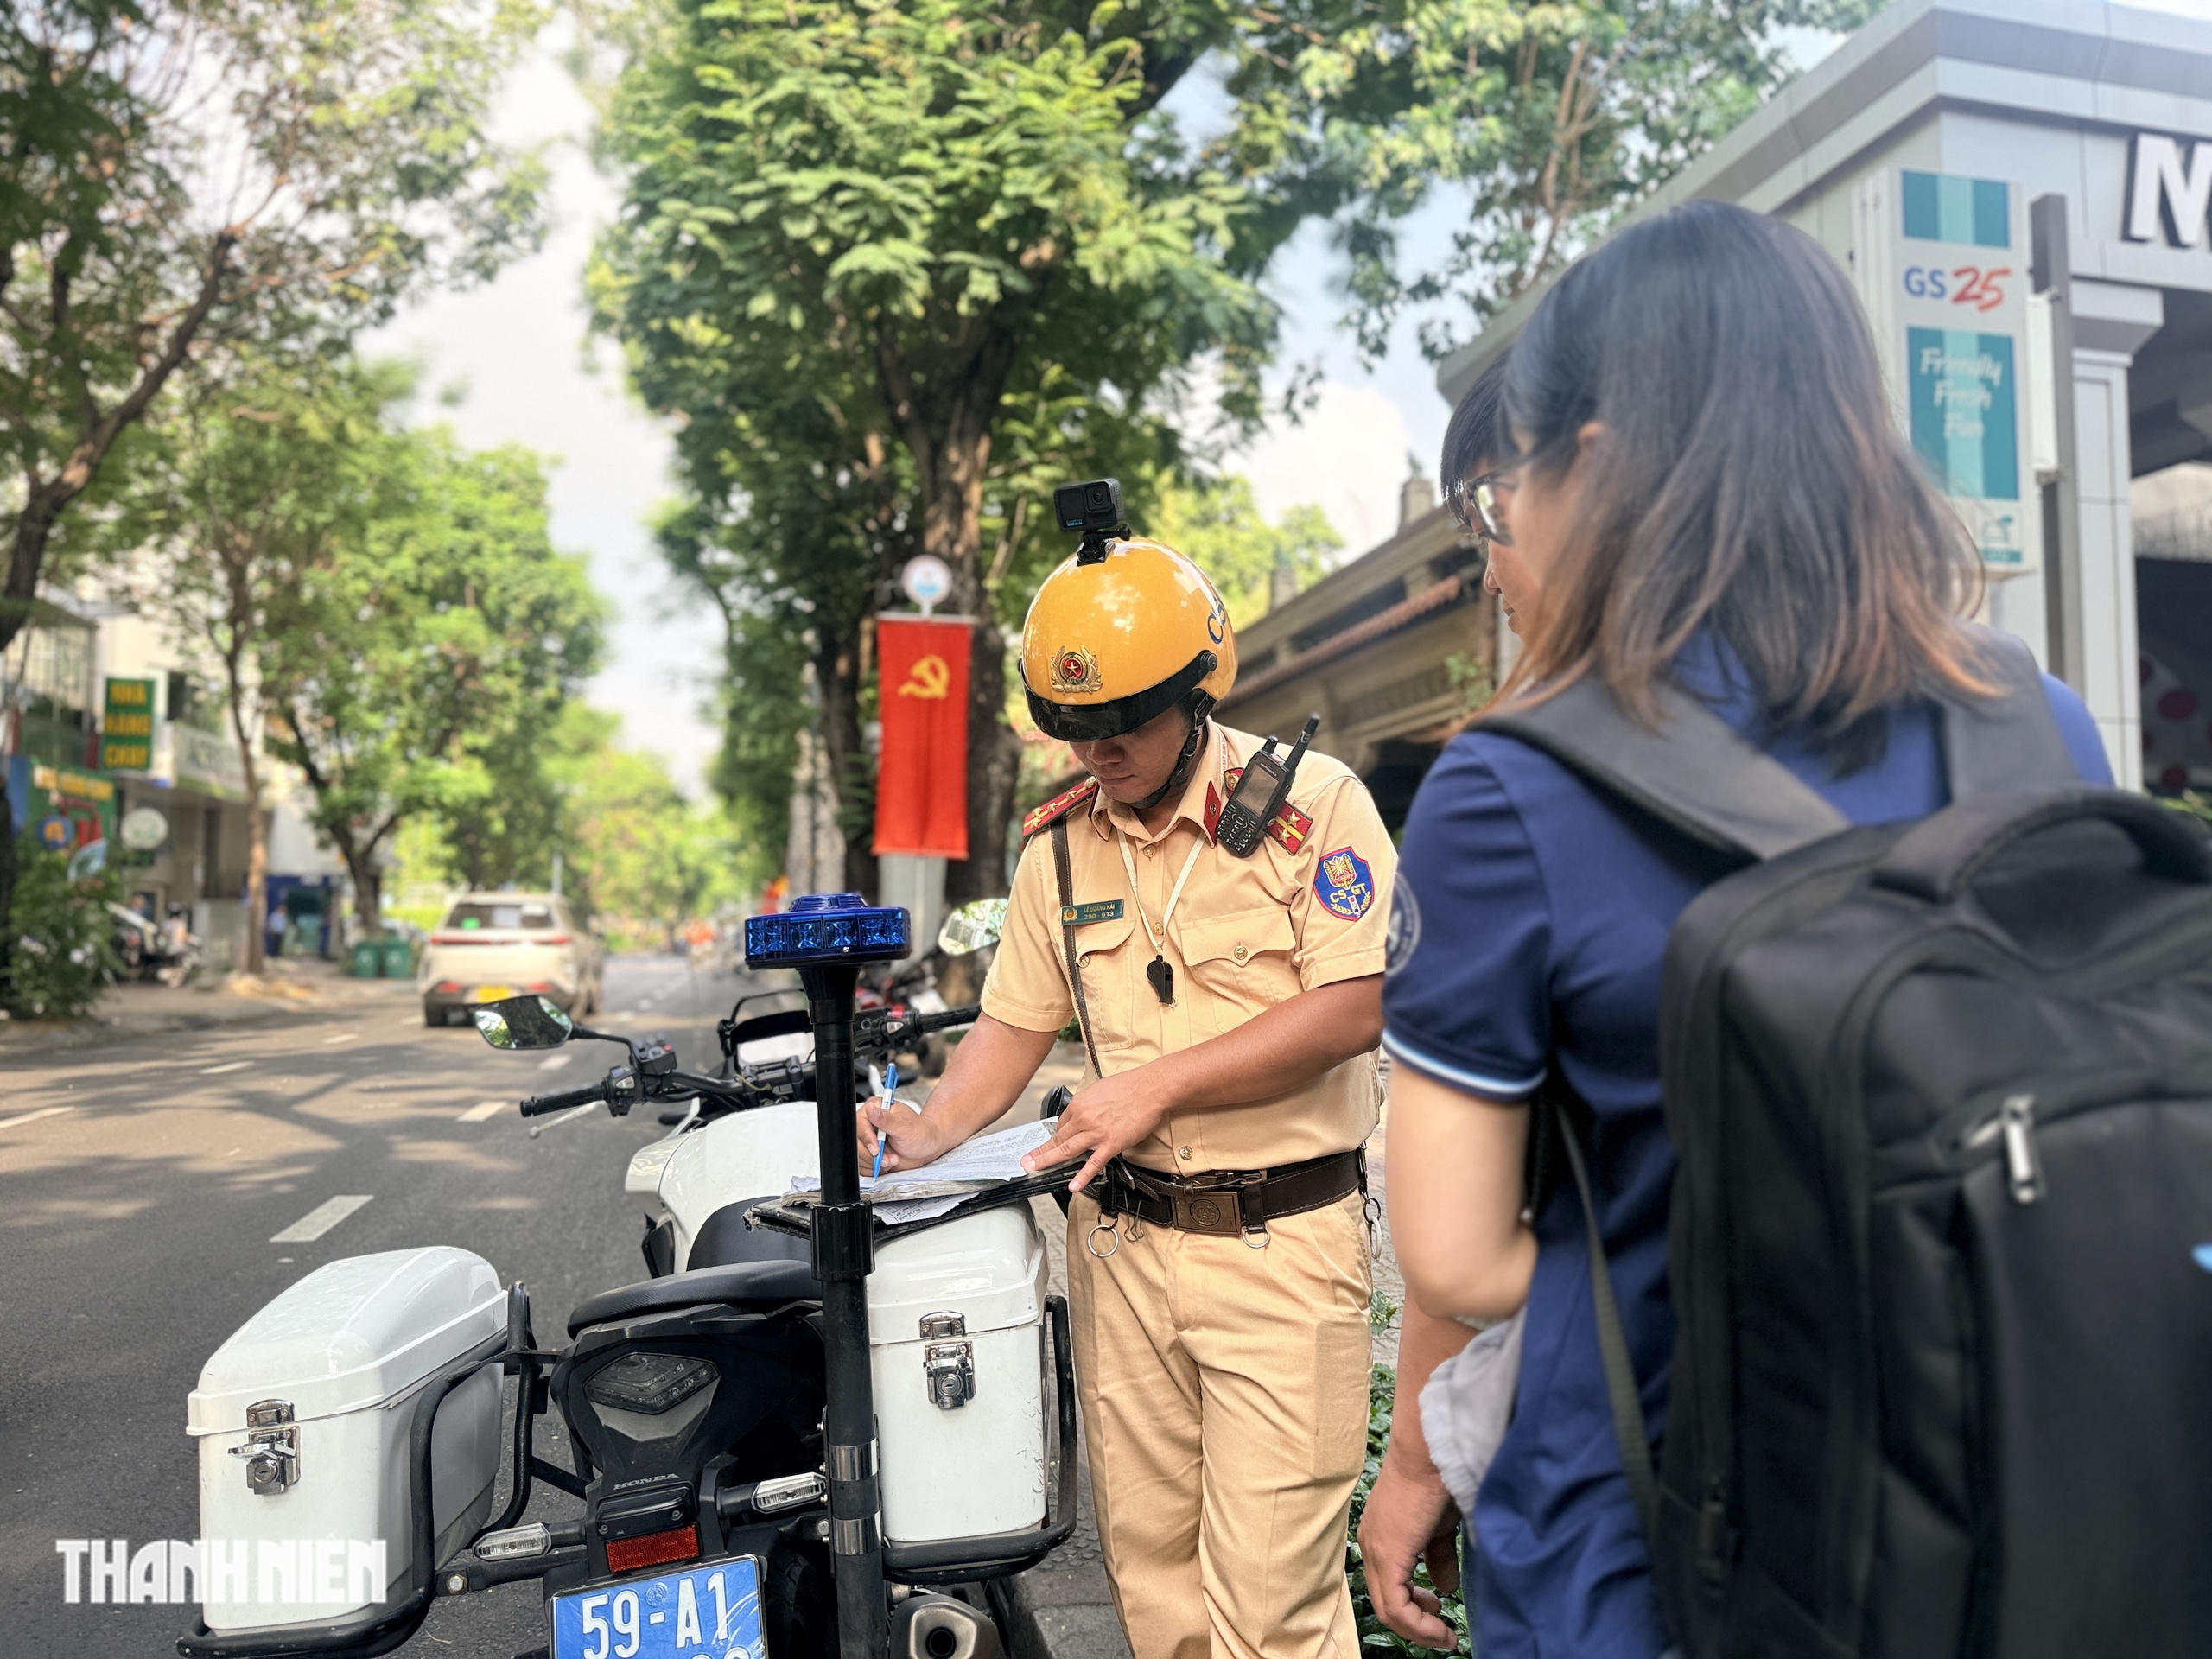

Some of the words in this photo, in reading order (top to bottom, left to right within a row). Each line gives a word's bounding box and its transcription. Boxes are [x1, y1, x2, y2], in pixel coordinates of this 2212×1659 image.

[1904, 265, 2012, 312] GS25
[1329, 889, 1347, 903] CS
[1350, 882, 1366, 896] GT
[613, 1472, 679, 1491] HONDA
[582, 1571, 728, 1659] 59-A1
